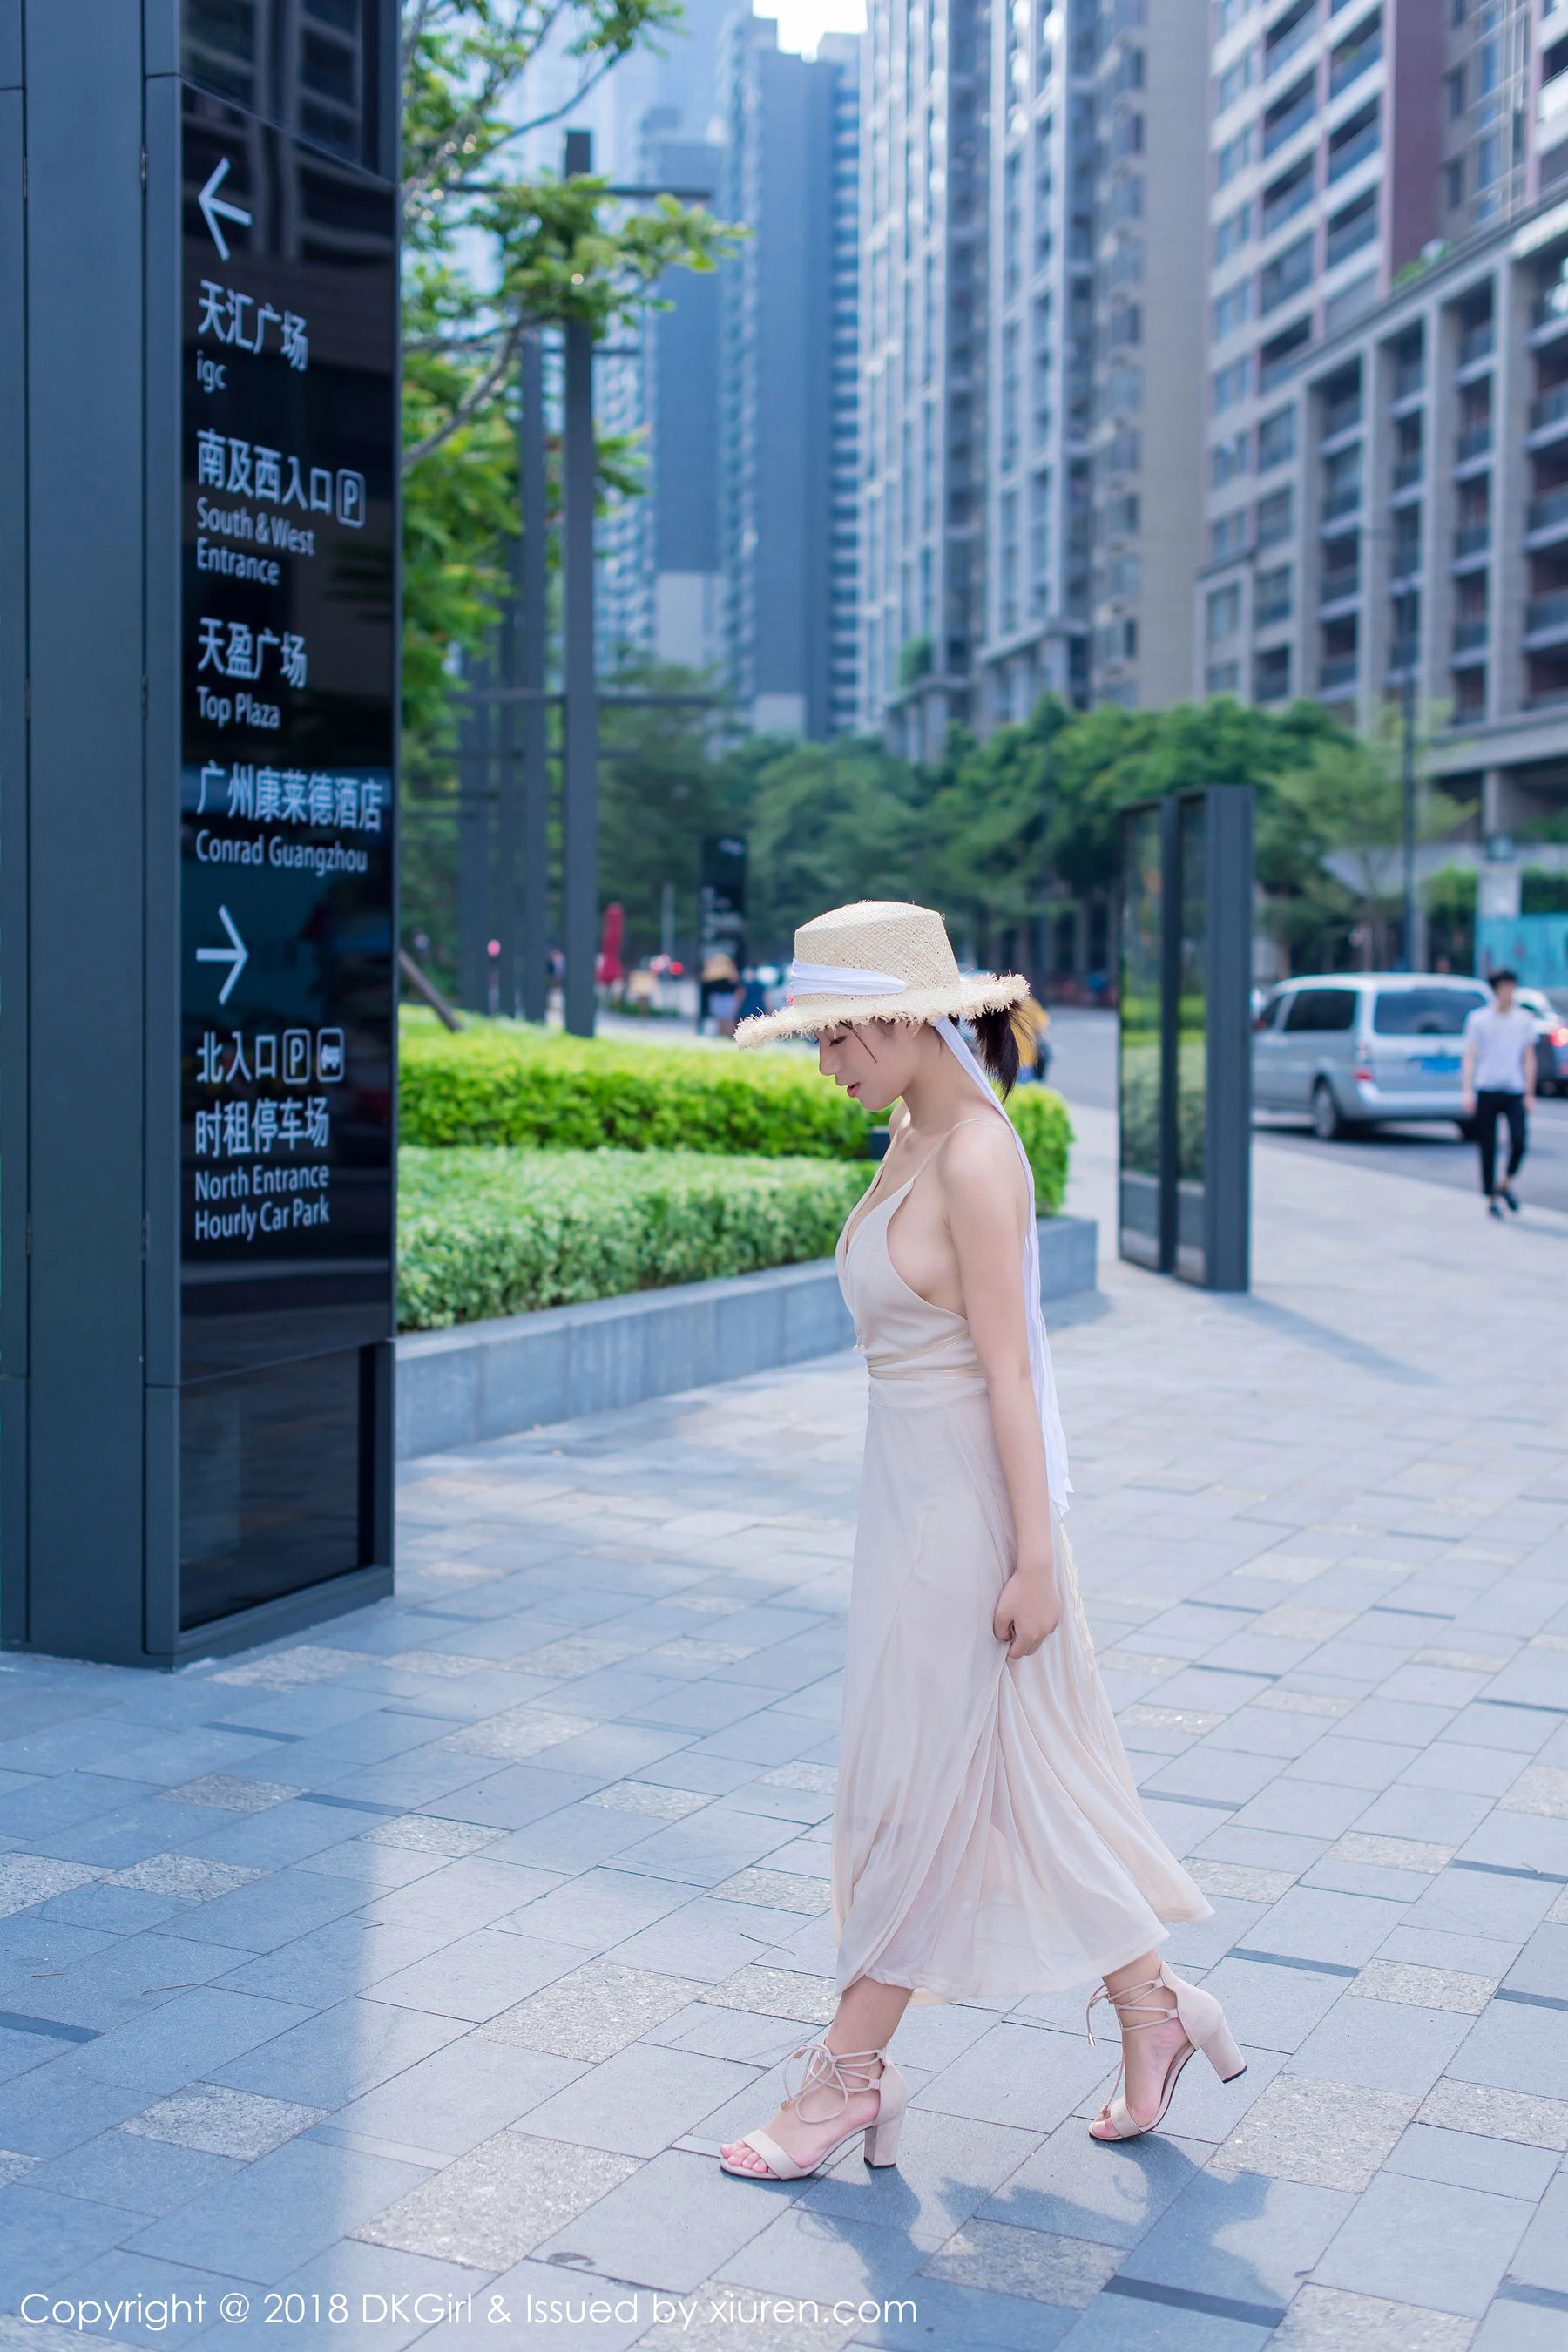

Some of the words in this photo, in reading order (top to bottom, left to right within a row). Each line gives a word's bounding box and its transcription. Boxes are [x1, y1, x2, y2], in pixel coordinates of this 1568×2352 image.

[197, 279, 308, 371] 天汇广场
[197, 349, 227, 393] igc
[196, 428, 333, 516] 南及西入口
[196, 497, 253, 541] South
[271, 517, 316, 557] West
[196, 537, 280, 586] Entrance
[197, 617, 308, 688] 天盈广场
[197, 686, 232, 727] Top
[235, 693, 280, 728] Plaza
[196, 760, 383, 832] 广州康莱德酒店
[196, 829, 265, 864] Conrad
[268, 835, 368, 877] Guangzhou
[196, 1031, 278, 1084] 北入口
[195, 1096, 329, 1158] 时租停车场
[195, 1166, 249, 1201] North
[253, 1164, 329, 1195] Entrance
[195, 1203, 258, 1241] Hourly
[260, 1200, 289, 1233] Car
[292, 1194, 330, 1227] Park
